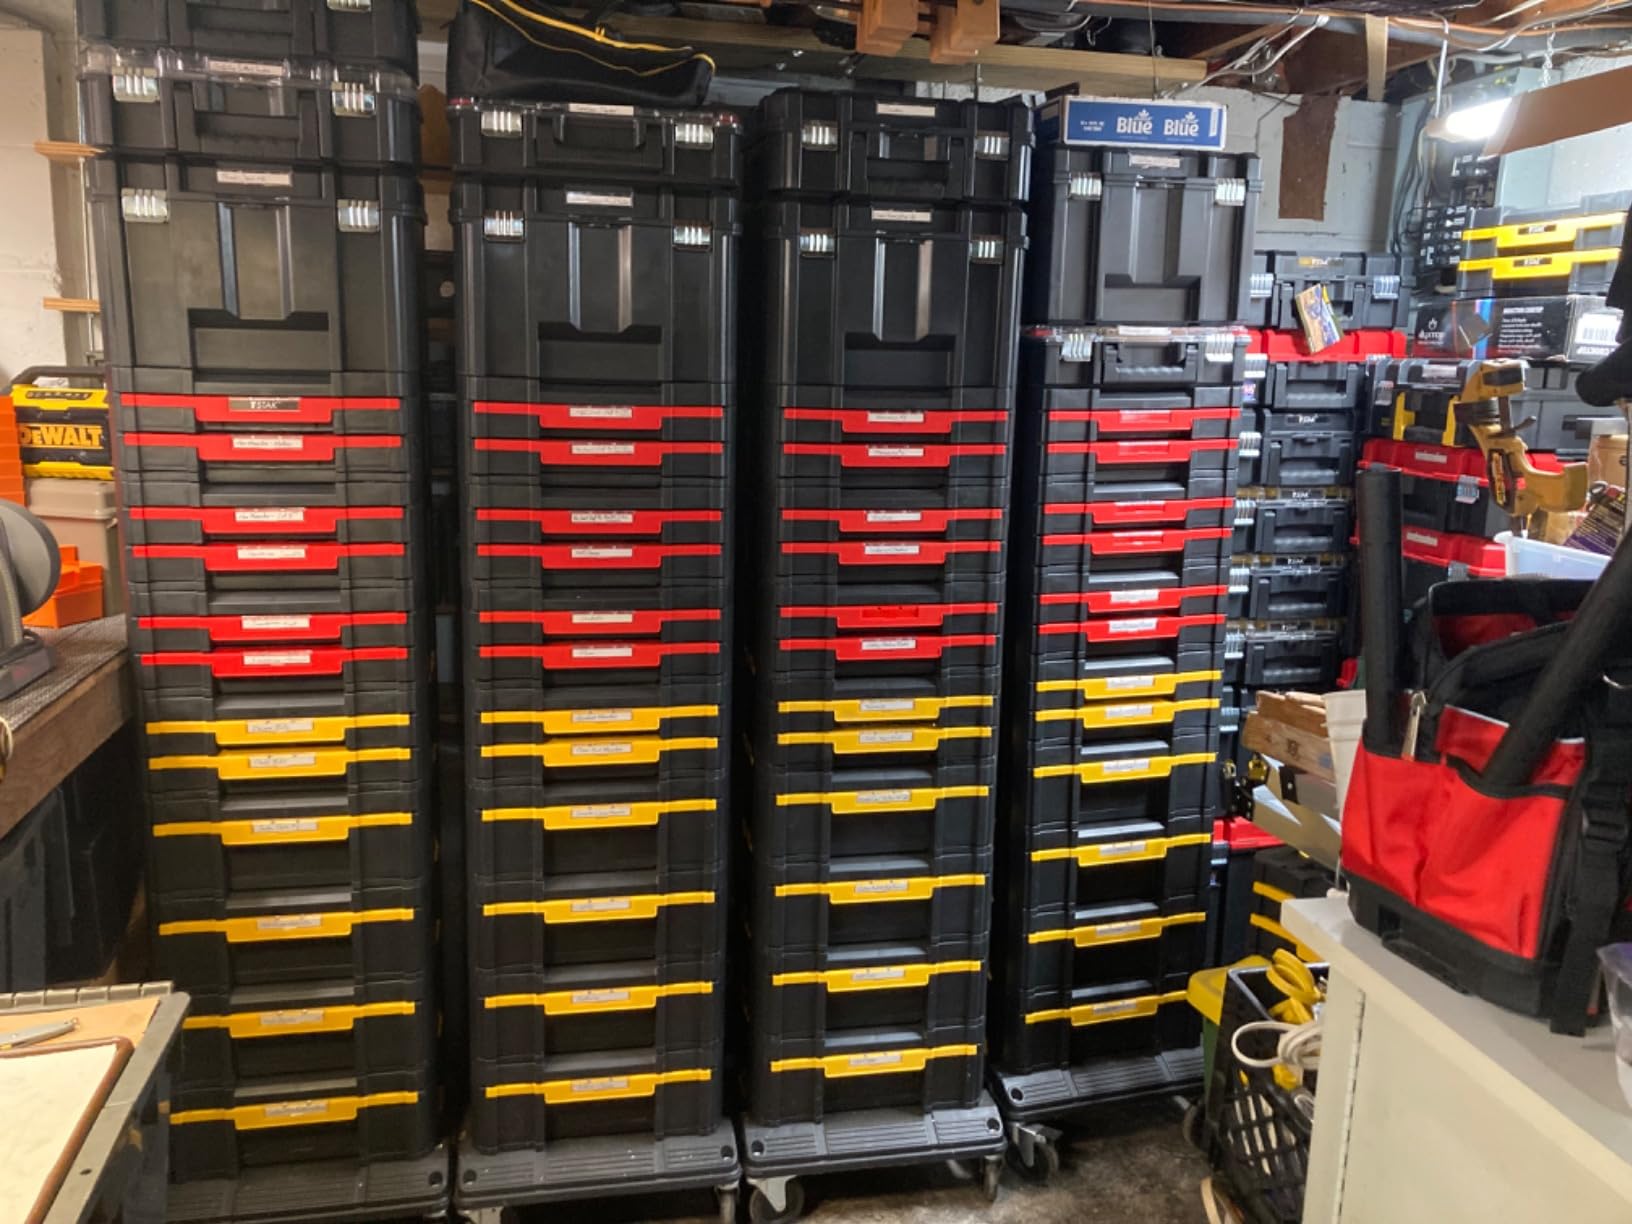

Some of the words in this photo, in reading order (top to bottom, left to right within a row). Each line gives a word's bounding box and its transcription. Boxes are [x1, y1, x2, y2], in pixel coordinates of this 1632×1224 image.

[1116, 116, 1153, 135] Blue
[1163, 118, 1200, 137] Blue
[18, 424, 104, 449] DEWALT
